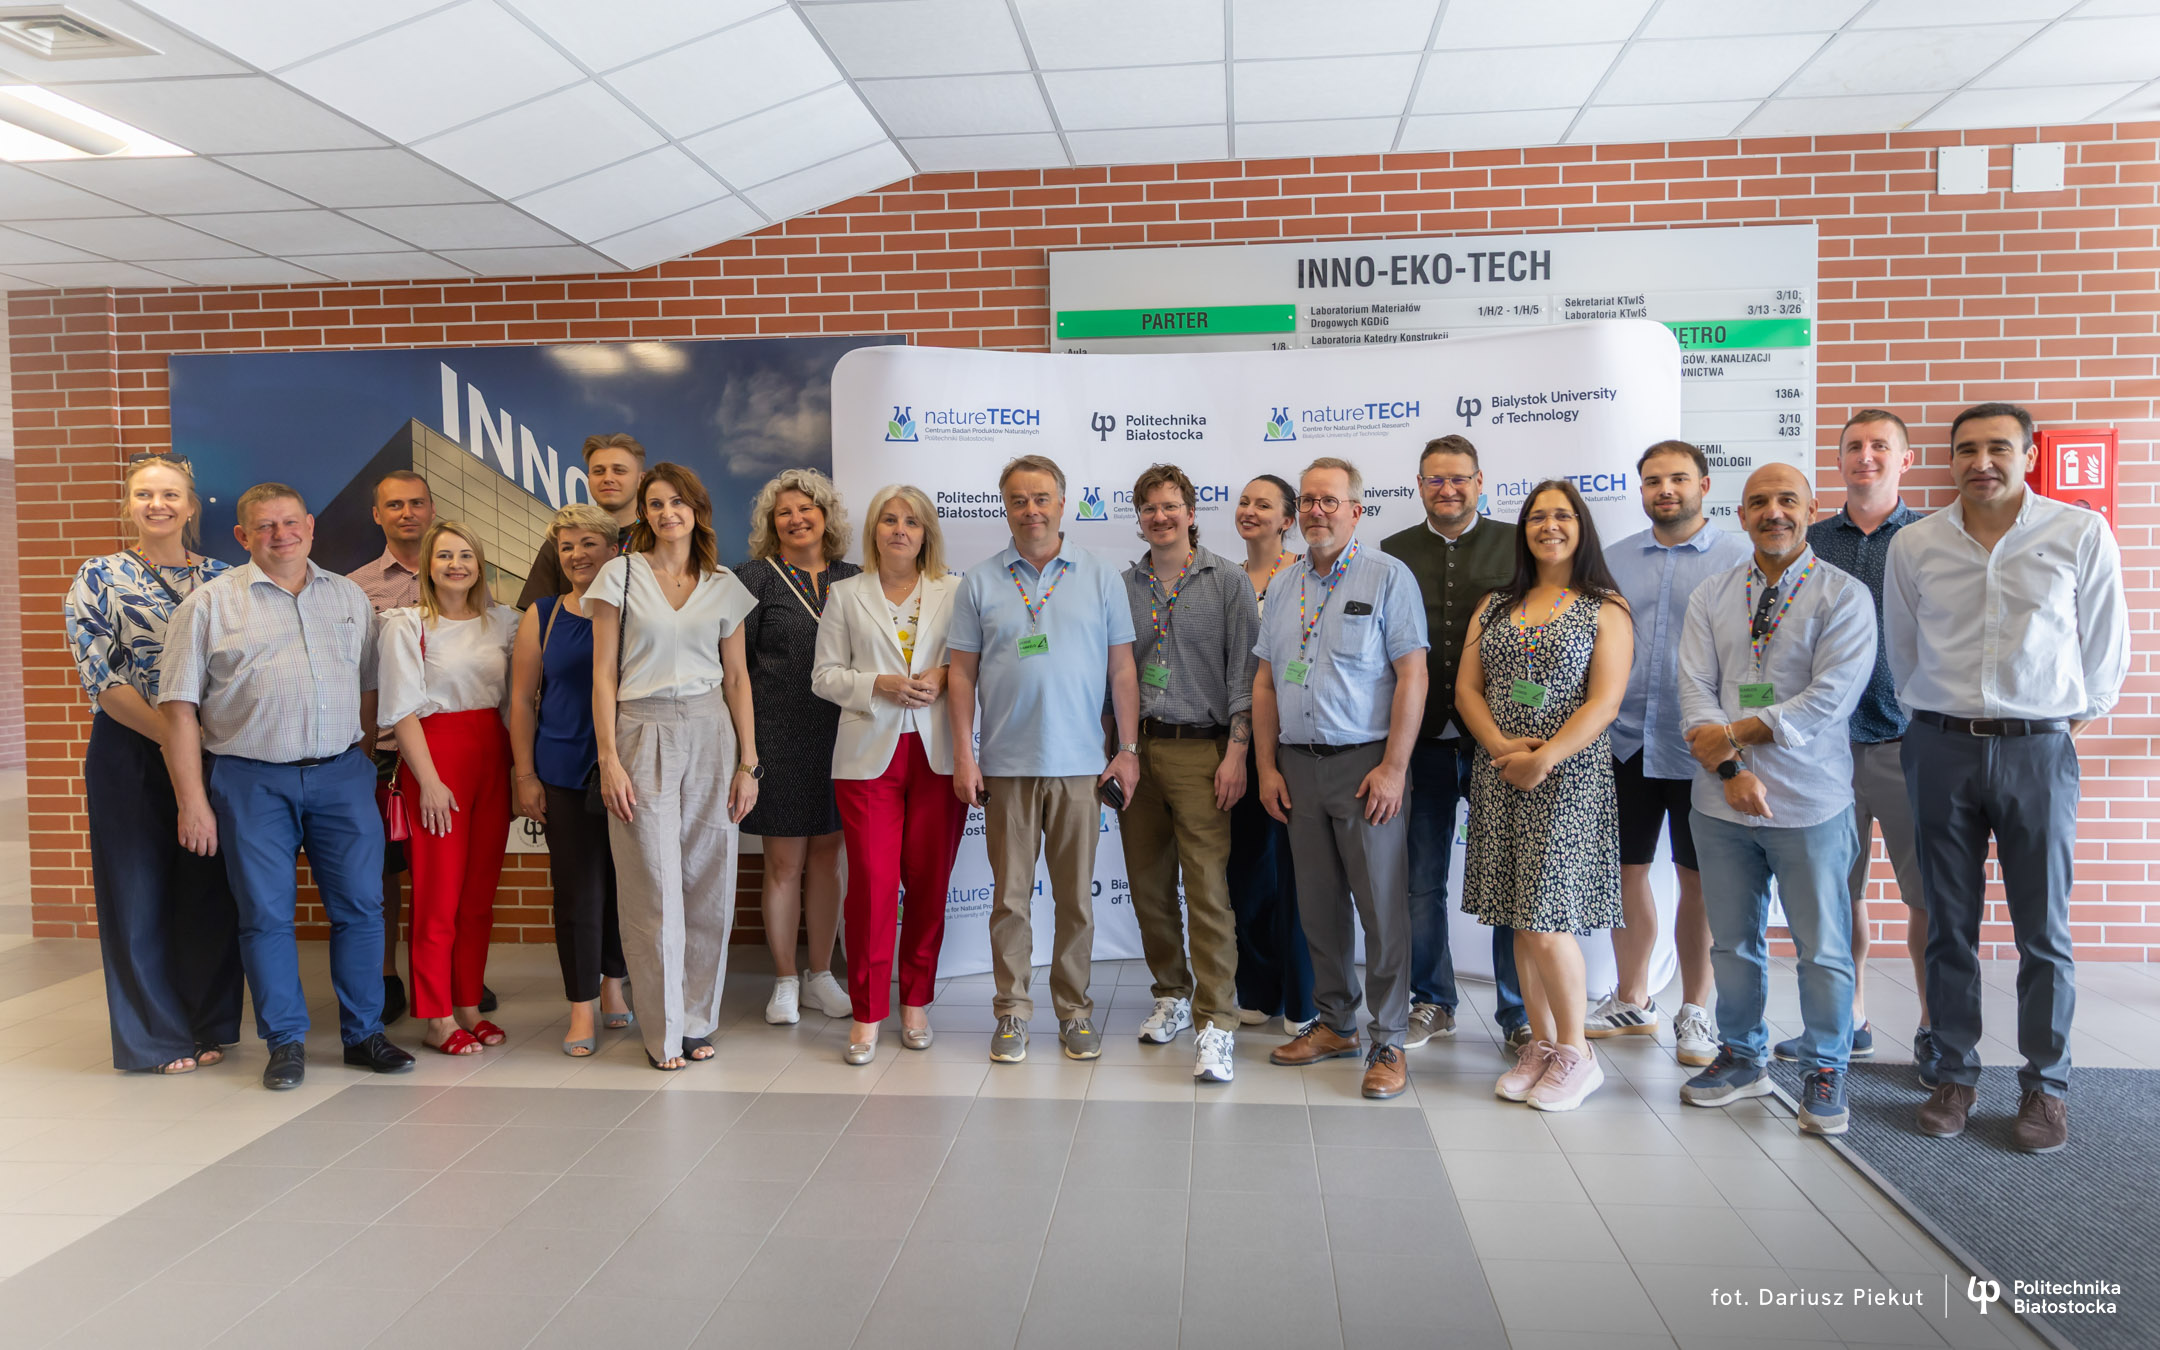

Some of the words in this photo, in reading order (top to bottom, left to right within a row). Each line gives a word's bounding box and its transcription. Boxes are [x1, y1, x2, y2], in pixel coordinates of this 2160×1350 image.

[1298, 250, 1551, 289] INNO-EKO-TECH
[1565, 297, 1615, 307] Sekretariat
[1617, 294, 1645, 306] KTwIŚ
[1310, 305, 1369, 316] Laboratorium
[1371, 303, 1421, 314] Materiałów
[1478, 305, 1504, 316] 1/H/2
[1513, 304, 1540, 315] 1/H/5
[1565, 308, 1617, 320] Laboratoria
[1619, 305, 1647, 318] KTwIŚ
[1747, 305, 1770, 315] 3/13
[1779, 304, 1802, 315] 3/26
[1142, 311, 1209, 330] PARTER
[1310, 317, 1359, 329] Drogowych
[1361, 316, 1389, 326] KGDiG
[1311, 334, 1361, 345] Laboratoria
[1363, 333, 1397, 344] Katedry
[1673, 326, 1727, 349] ĘTRO
[1271, 342, 1286, 351] 1/8
[1711, 353, 1771, 364] KANALIZACJI
[1681, 367, 1724, 377] WNICTWA
[1491, 392, 1548, 409] Bialystok
[1550, 387, 1618, 403] University
[1775, 388, 1801, 399] 136A
[925, 407, 1040, 426] natureTECH
[1302, 400, 1420, 423] natureTECH
[1491, 412, 1504, 425] of
[1506, 408, 1580, 424] Technology
[1126, 414, 1207, 426] Politechnika
[1778, 413, 1801, 424] 3/10
[1382, 421, 1410, 429] Research
[972, 427, 1003, 435] Produktów
[1004, 428, 1040, 436] Naturalnych
[1126, 428, 1204, 441] Białostocka
[1778, 426, 1801, 437] 4/33
[1708, 456, 1752, 467] NOLOGII
[937, 491, 1002, 504] Politechni
[1363, 485, 1415, 500] niversity
[1584, 494, 1627, 503] Naturalnych
[937, 506, 1008, 518] Białostock
[1710, 506, 1731, 517] 4/15
